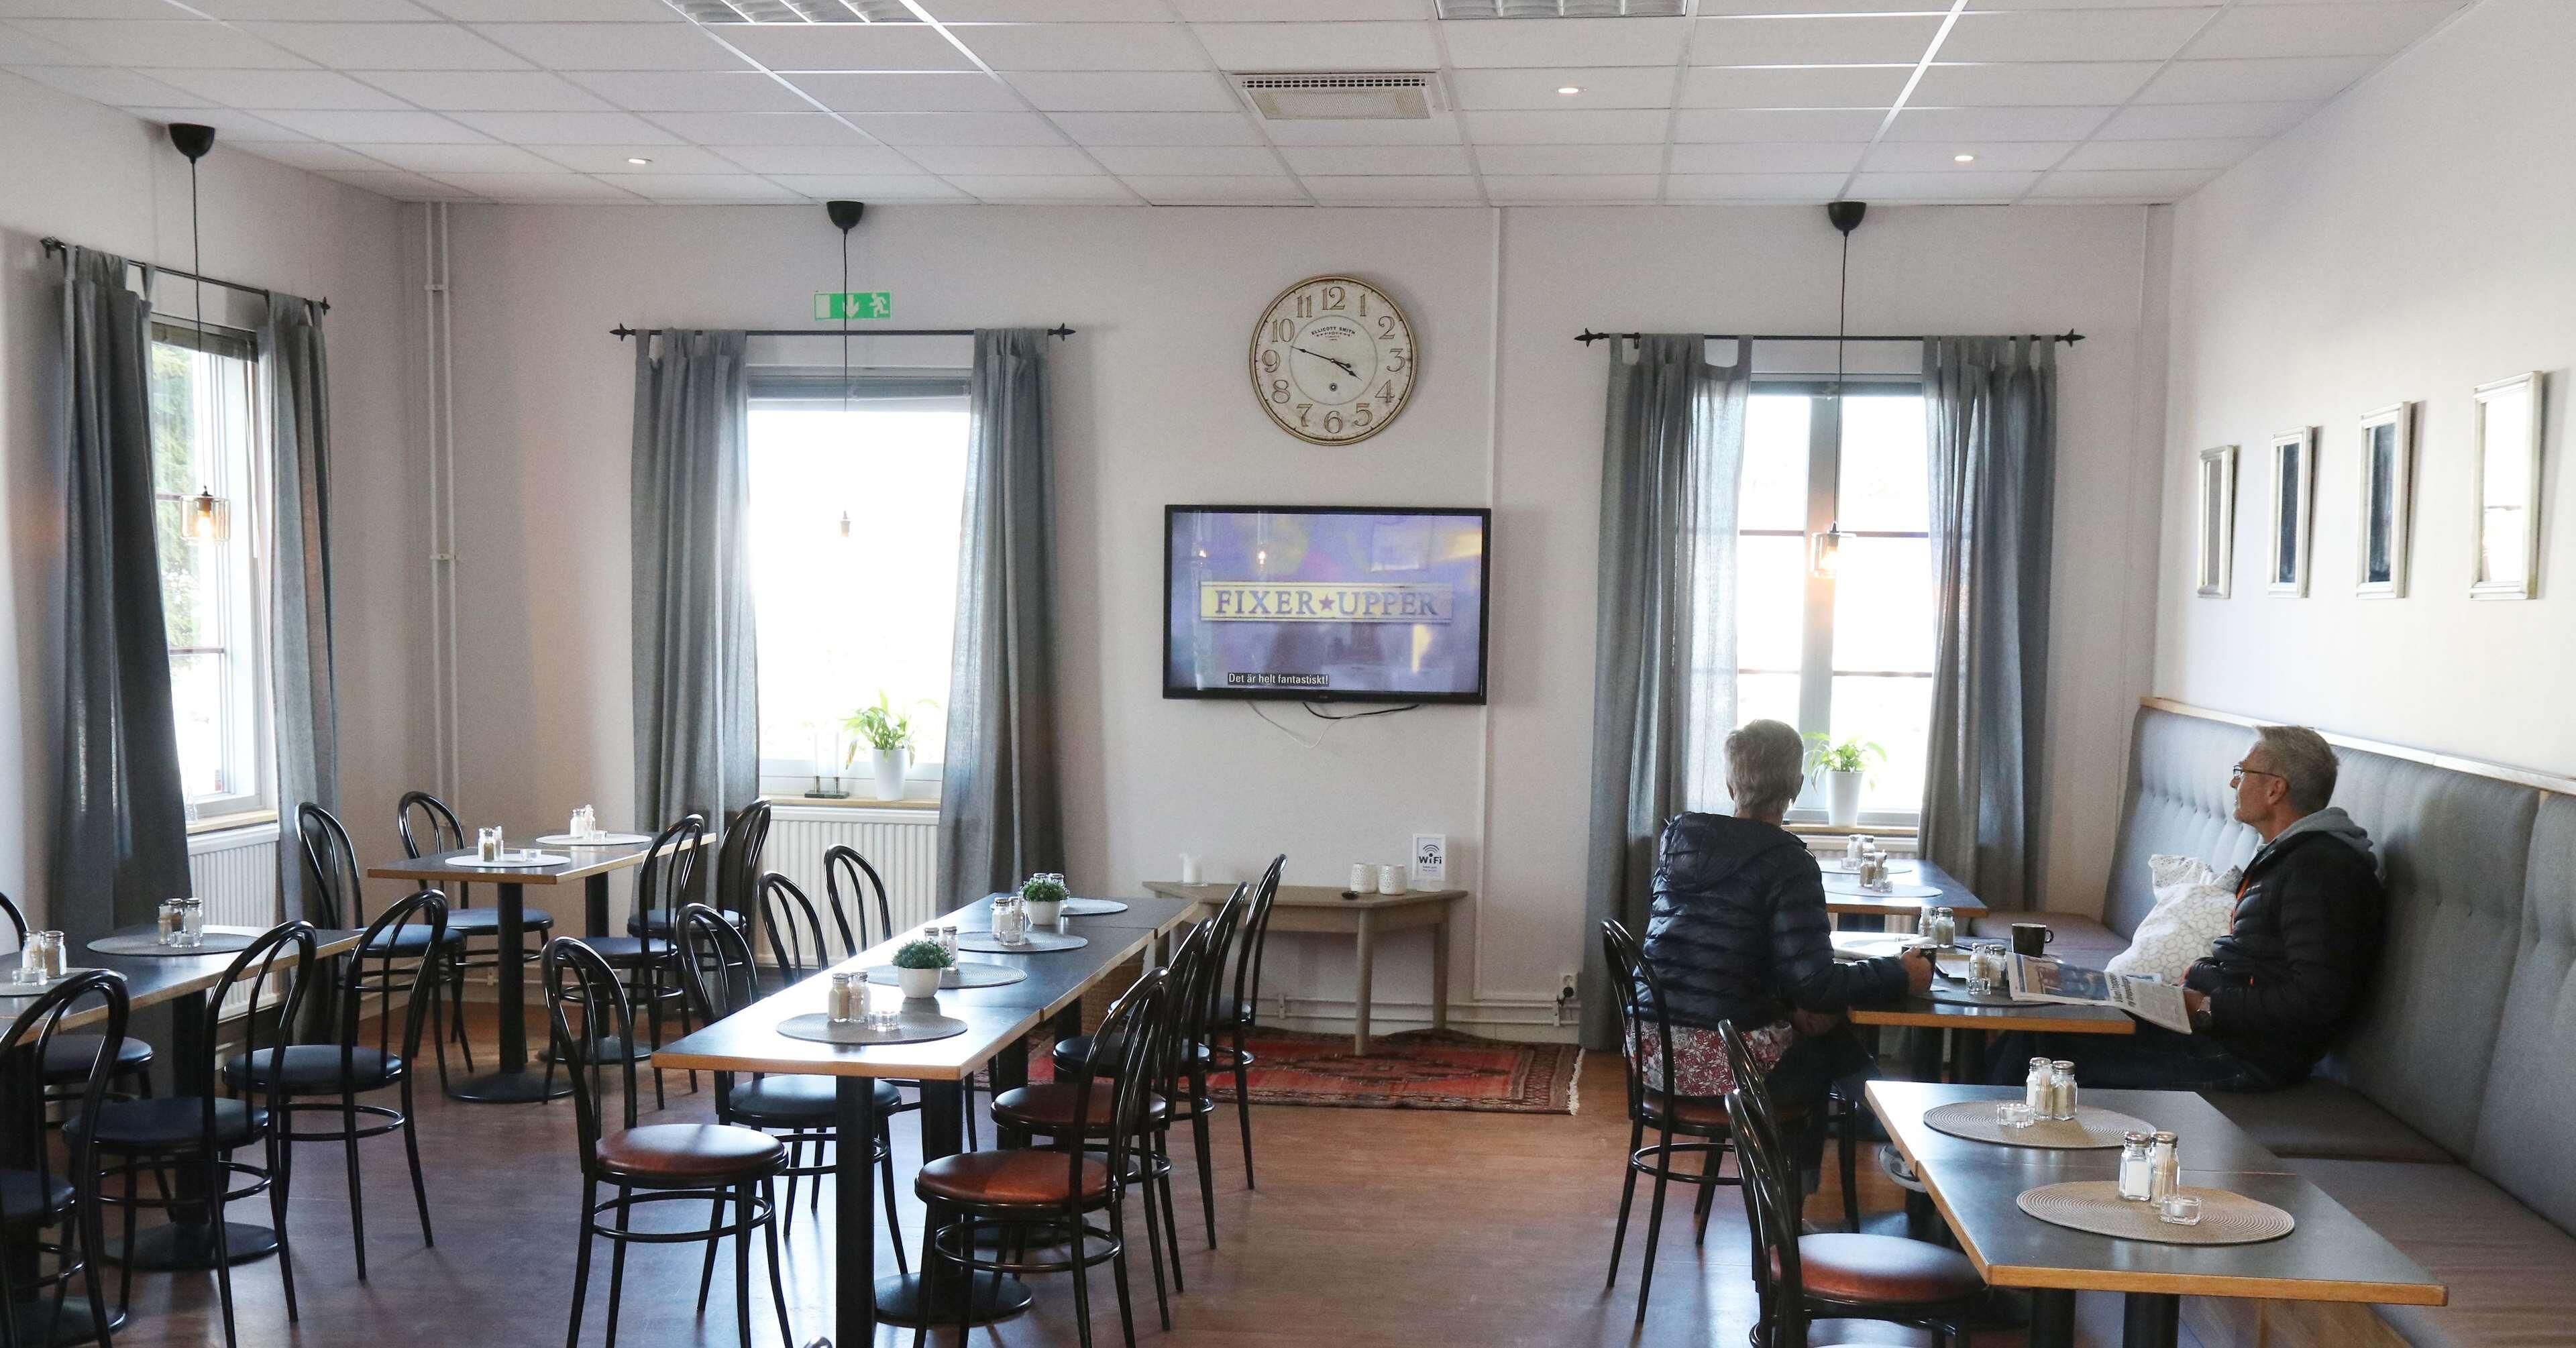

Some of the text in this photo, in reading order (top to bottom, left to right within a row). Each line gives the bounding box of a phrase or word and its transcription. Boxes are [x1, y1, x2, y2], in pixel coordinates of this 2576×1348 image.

[1296, 294, 1313, 318] 11
[1322, 286, 1346, 310] 12
[1359, 293, 1366, 317] 1
[1271, 318, 1295, 343] 10
[1311, 327, 1356, 335] ELLICOTT SMITH
[1378, 316, 1395, 339] 2
[1261, 349, 1281, 373] 9
[1386, 348, 1406, 372] 3
[1271, 380, 1291, 404] 8
[1375, 379, 1395, 403] 4
[1296, 403, 1313, 427] 7
[1324, 410, 1343, 434] 6
[1354, 403, 1373, 427] 5
[1215, 589, 1439, 616] FIXER UPPER
[1228, 673, 1328, 685] Det är helt fantastiskt!
[1419, 853, 1442, 864] WiFi
